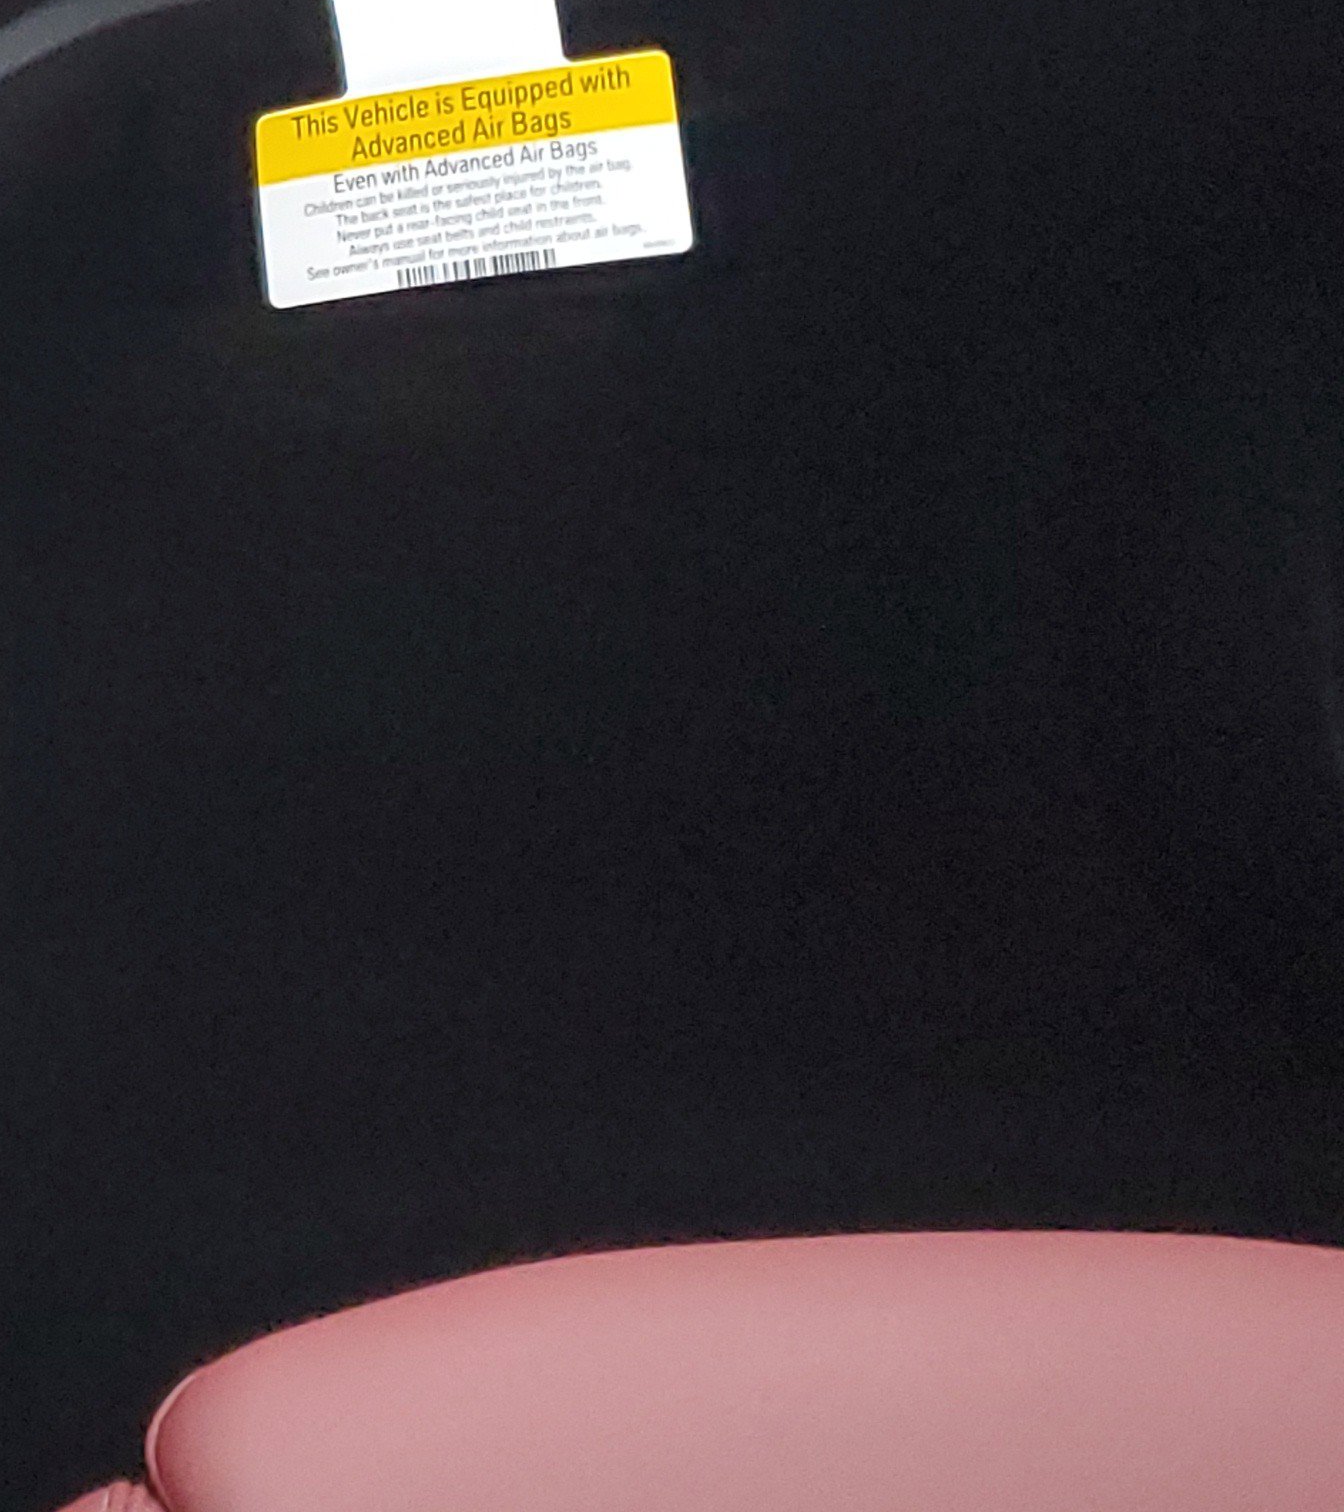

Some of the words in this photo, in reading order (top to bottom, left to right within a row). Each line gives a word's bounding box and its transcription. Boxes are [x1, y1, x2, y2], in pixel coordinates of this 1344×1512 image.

[291, 111, 338, 140] This
[343, 95, 429, 129] Vehicle
[434, 91, 455, 116] is
[461, 73, 573, 113] Equipped
[579, 64, 631, 94] with
[351, 118, 466, 162] Advanced
[472, 114, 504, 143] Air
[511, 110, 572, 138] Bags
[333, 173, 378, 194] Even
[381, 163, 420, 186] with
[424, 147, 515, 178] Advanced
[520, 145, 545, 164] Air
[549, 140, 598, 162] Bags
